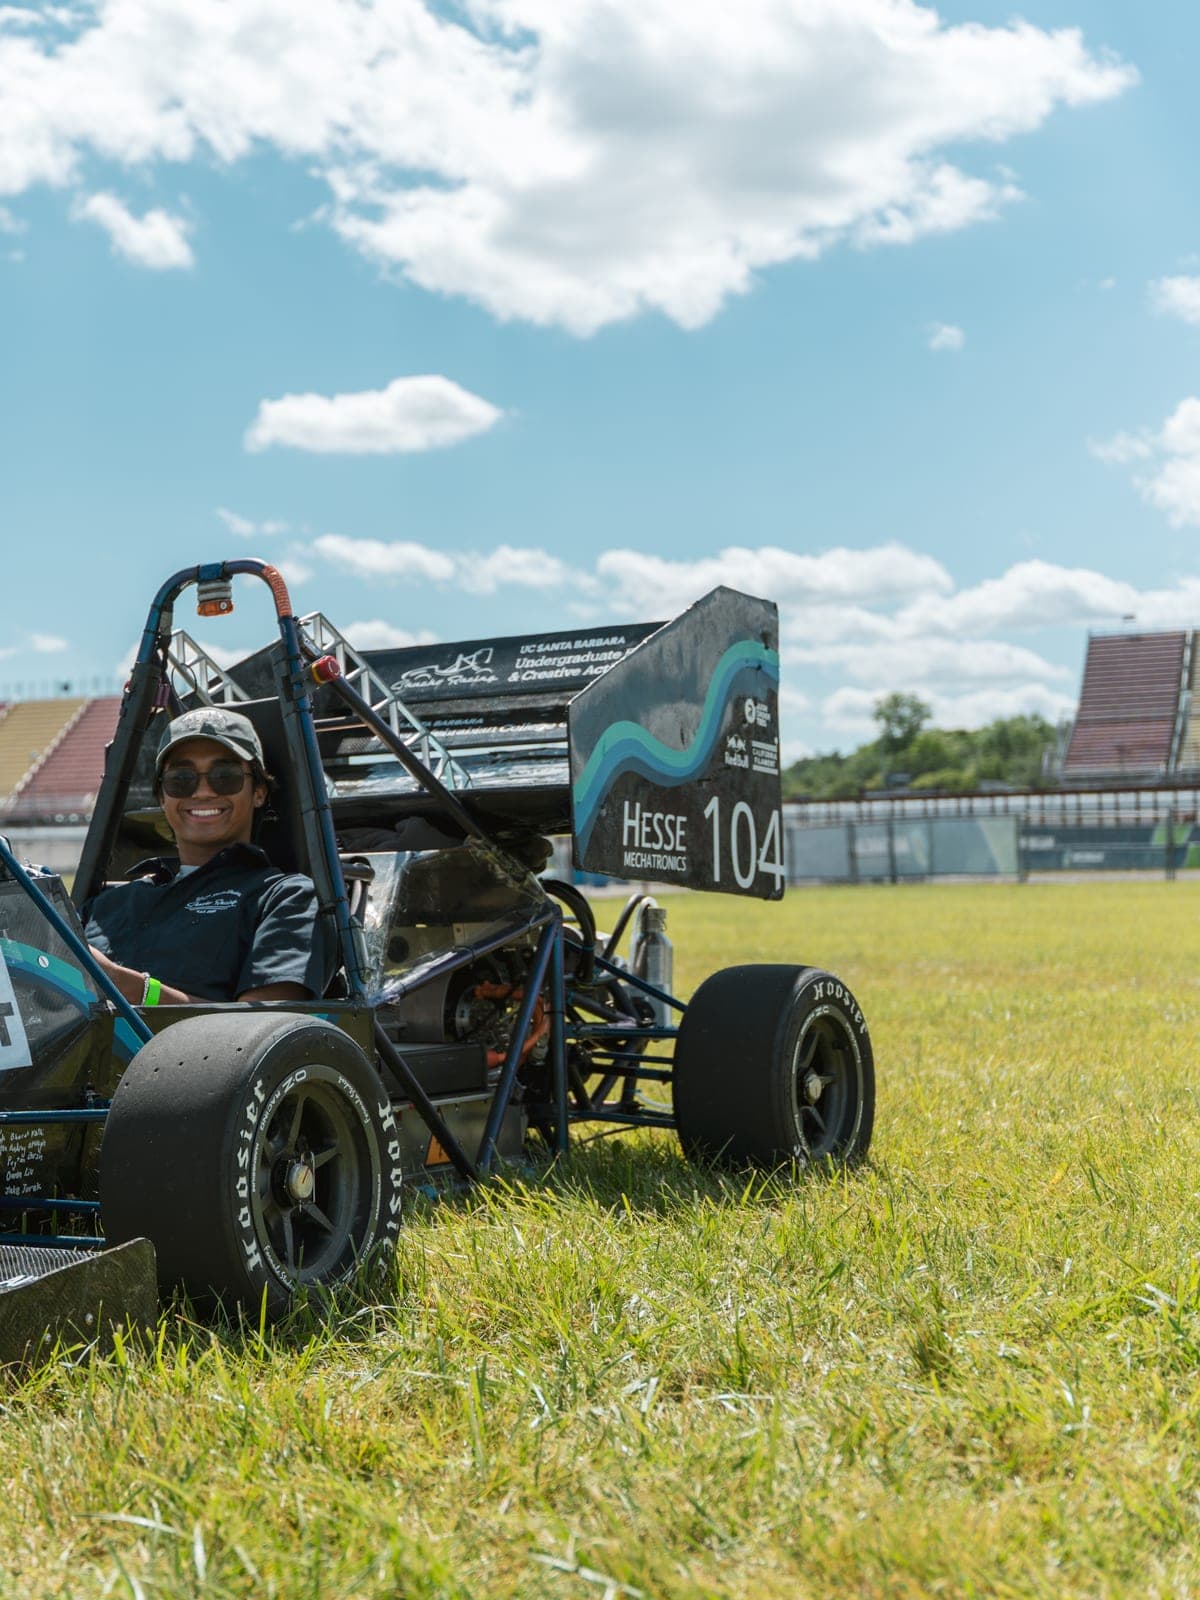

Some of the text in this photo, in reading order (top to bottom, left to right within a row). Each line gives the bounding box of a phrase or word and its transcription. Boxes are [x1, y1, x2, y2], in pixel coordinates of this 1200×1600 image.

[520, 636, 627, 655] UC SANTA BARBARA
[515, 649, 623, 669] Undergraduate
[507, 671, 519, 682] &
[521, 666, 582, 681] Creative
[703, 795, 786, 892] 104
[623, 851, 687, 872] MECHATRONICS
[236, 1079, 265, 1272] Hoosier
